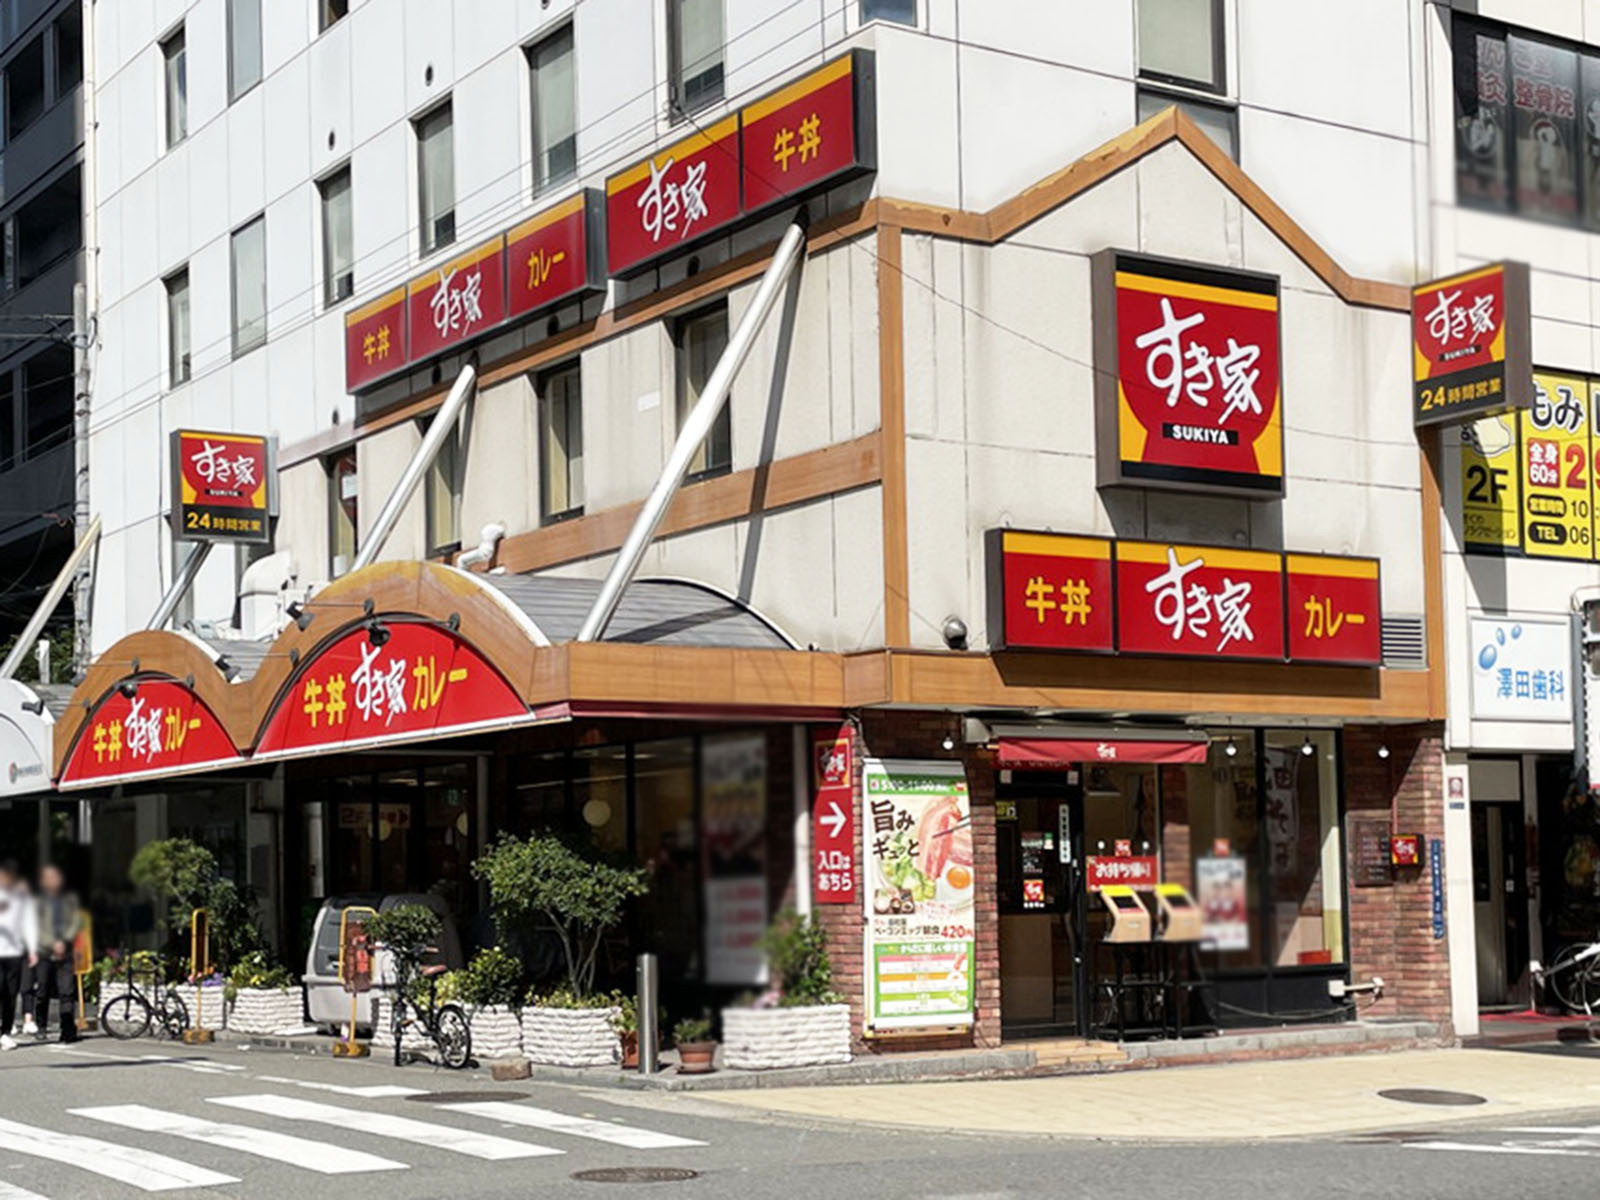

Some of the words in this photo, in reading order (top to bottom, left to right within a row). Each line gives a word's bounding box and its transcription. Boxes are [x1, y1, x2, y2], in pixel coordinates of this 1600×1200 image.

[773, 113, 821, 172] 牛丼
[637, 157, 709, 242] すき家
[527, 249, 565, 290] カレー
[430, 265, 483, 338] すき家
[1424, 289, 1496, 345] すき家
[363, 324, 391, 365] 牛丼
[1136, 297, 1263, 425] すき家
[1531, 384, 1600, 434] もみ
[1172, 424, 1230, 445] SUKIYA
[1529, 442, 1558, 465] 全身
[191, 440, 256, 490] すき家
[1467, 465, 1509, 504] 2F
[1529, 463, 1558, 485] 60分
[1535, 524, 1560, 541] TEL
[1025, 576, 1092, 626] 牛丼
[1145, 547, 1255, 653] すき家
[1304, 594, 1366, 639] カレー
[303, 673, 347, 728] 牛丼
[350, 642, 407, 728] すき家
[412, 656, 469, 711] カレー
[93, 719, 123, 764] 牛丼
[124, 697, 163, 764] すき家
[165, 707, 202, 752] カレー
[870, 799, 915, 833] 旨み
[818, 850, 851, 870] 入口は
